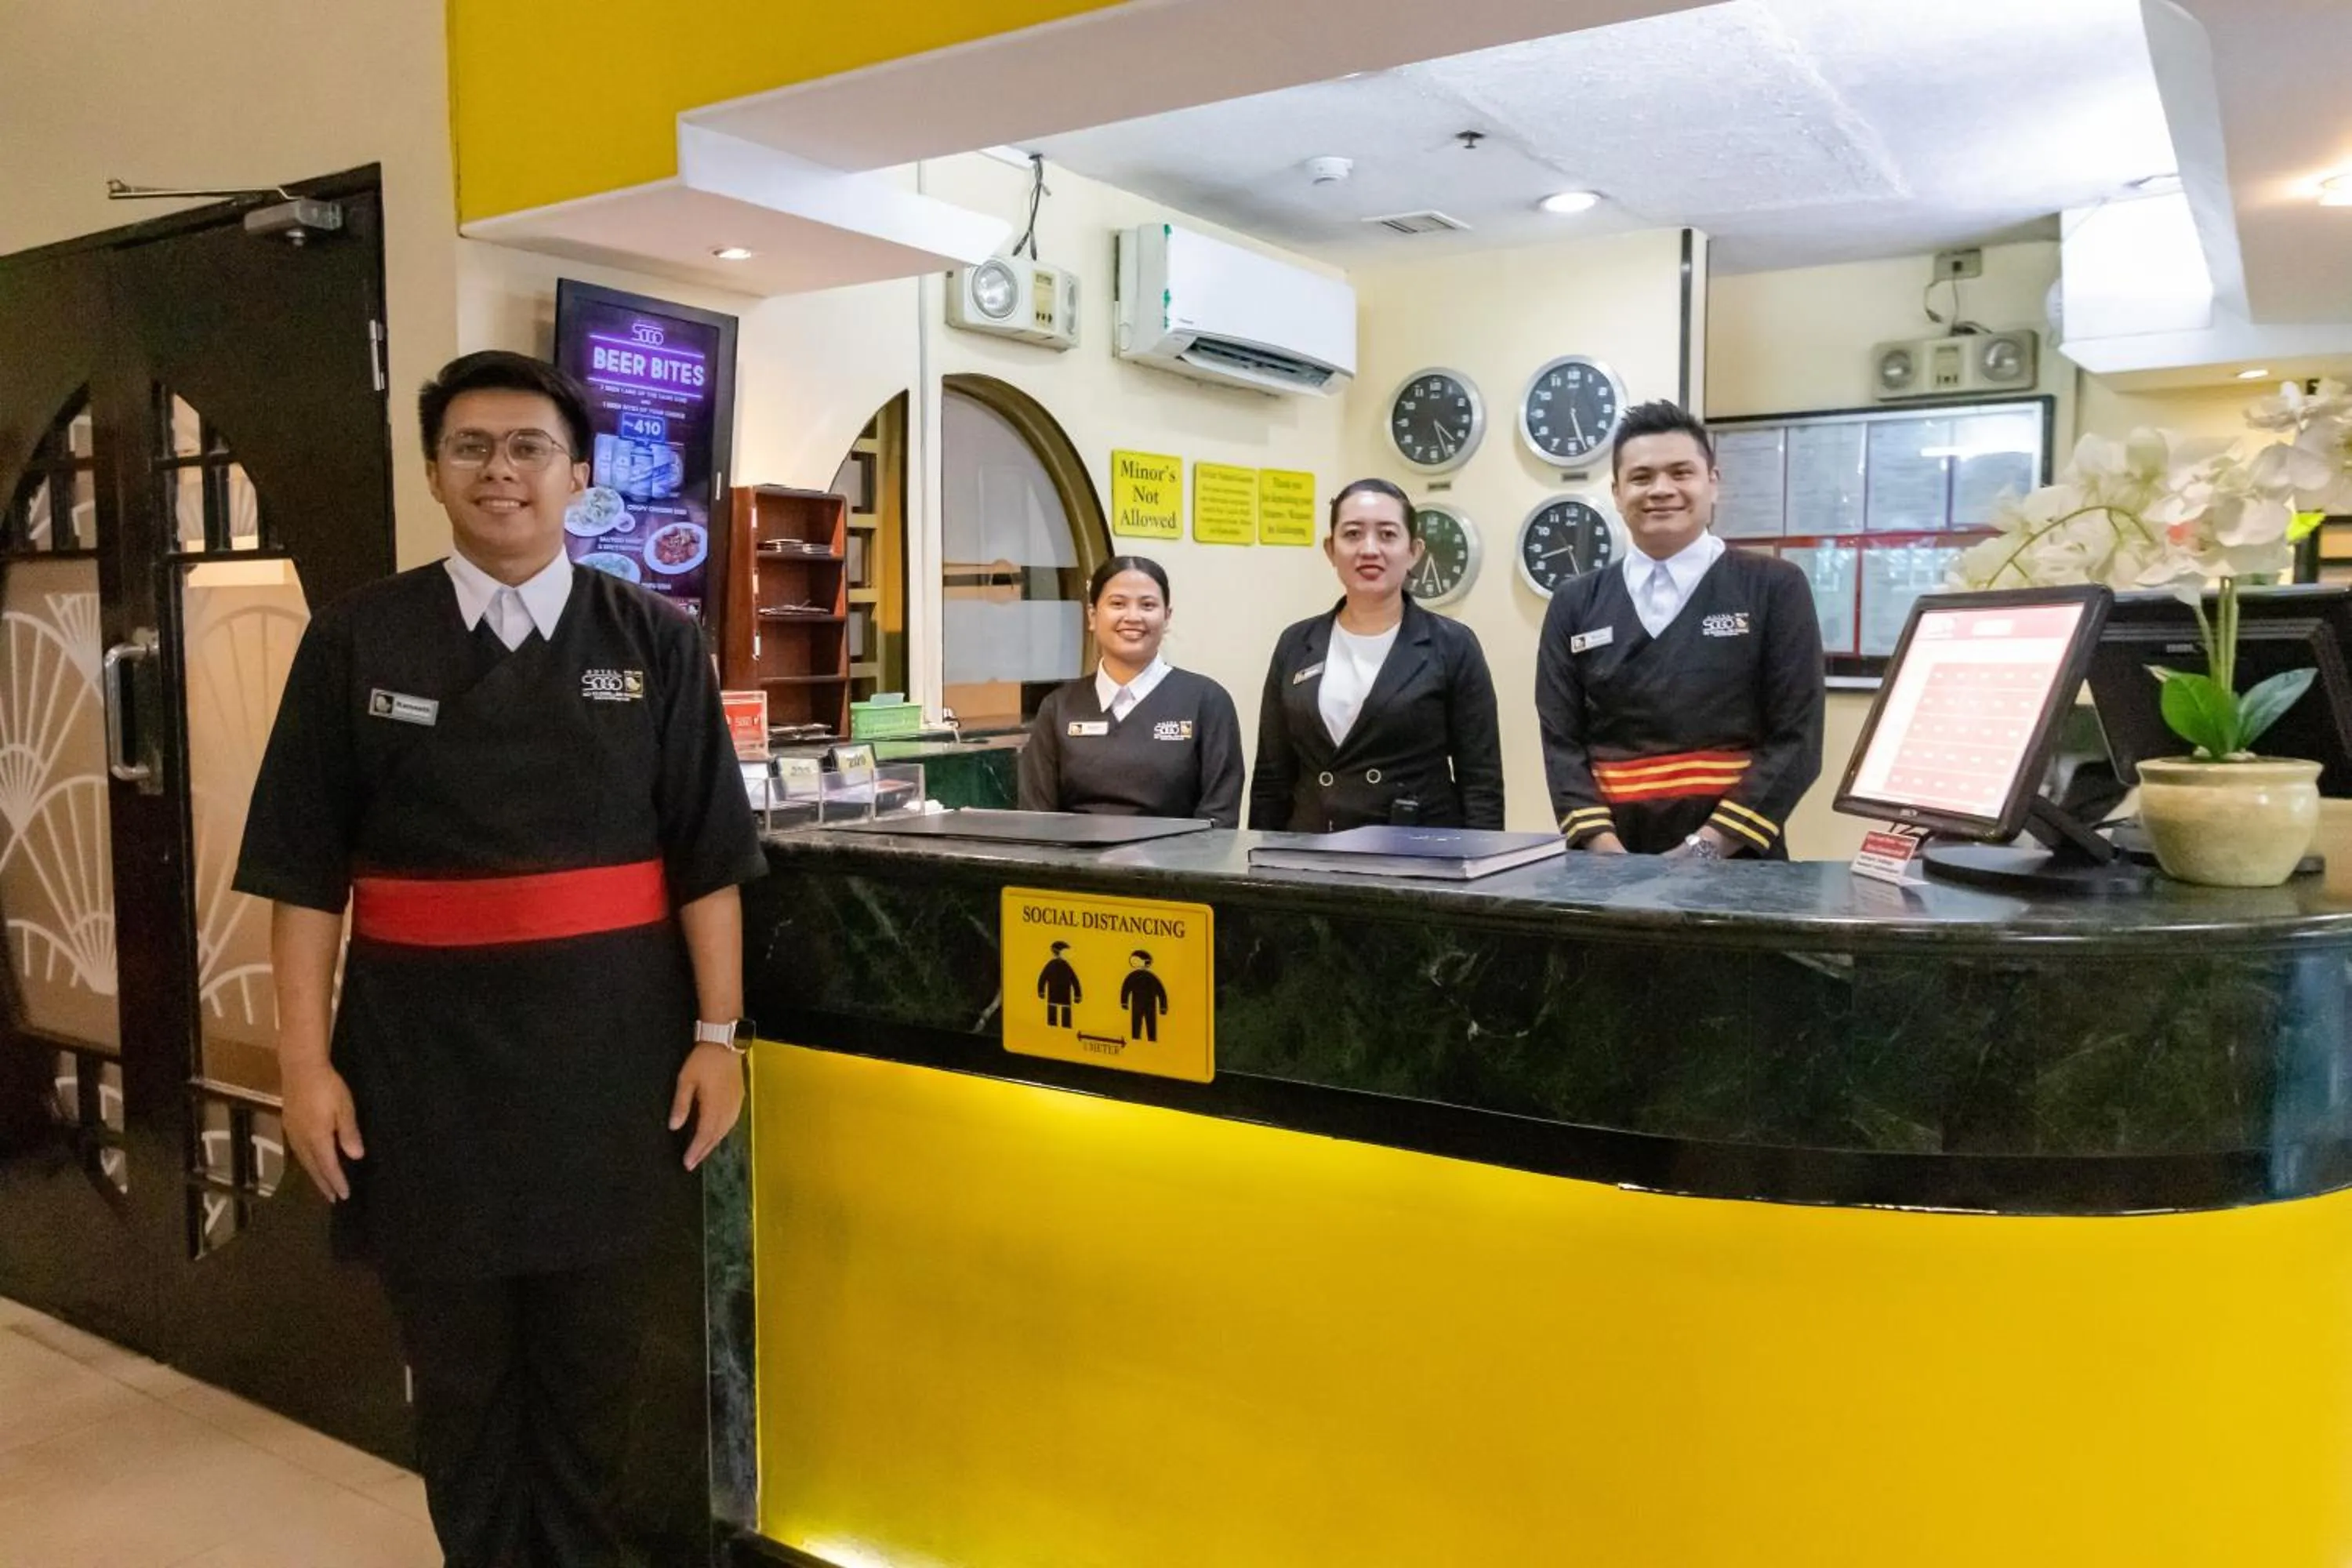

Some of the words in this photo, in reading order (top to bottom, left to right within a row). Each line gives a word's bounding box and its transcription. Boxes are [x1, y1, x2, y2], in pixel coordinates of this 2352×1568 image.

[593, 346, 645, 376] BEER
[651, 357, 704, 386] BITES
[634, 419, 660, 436] 410
[1120, 459, 1176, 483] Minor's
[1133, 485, 1159, 505] Not
[1120, 508, 1177, 529] Allowed
[1022, 905, 1080, 927] SOCIAL
[1083, 911, 1187, 939] DISTANCING
[1090, 1043, 1121, 1055] METER
